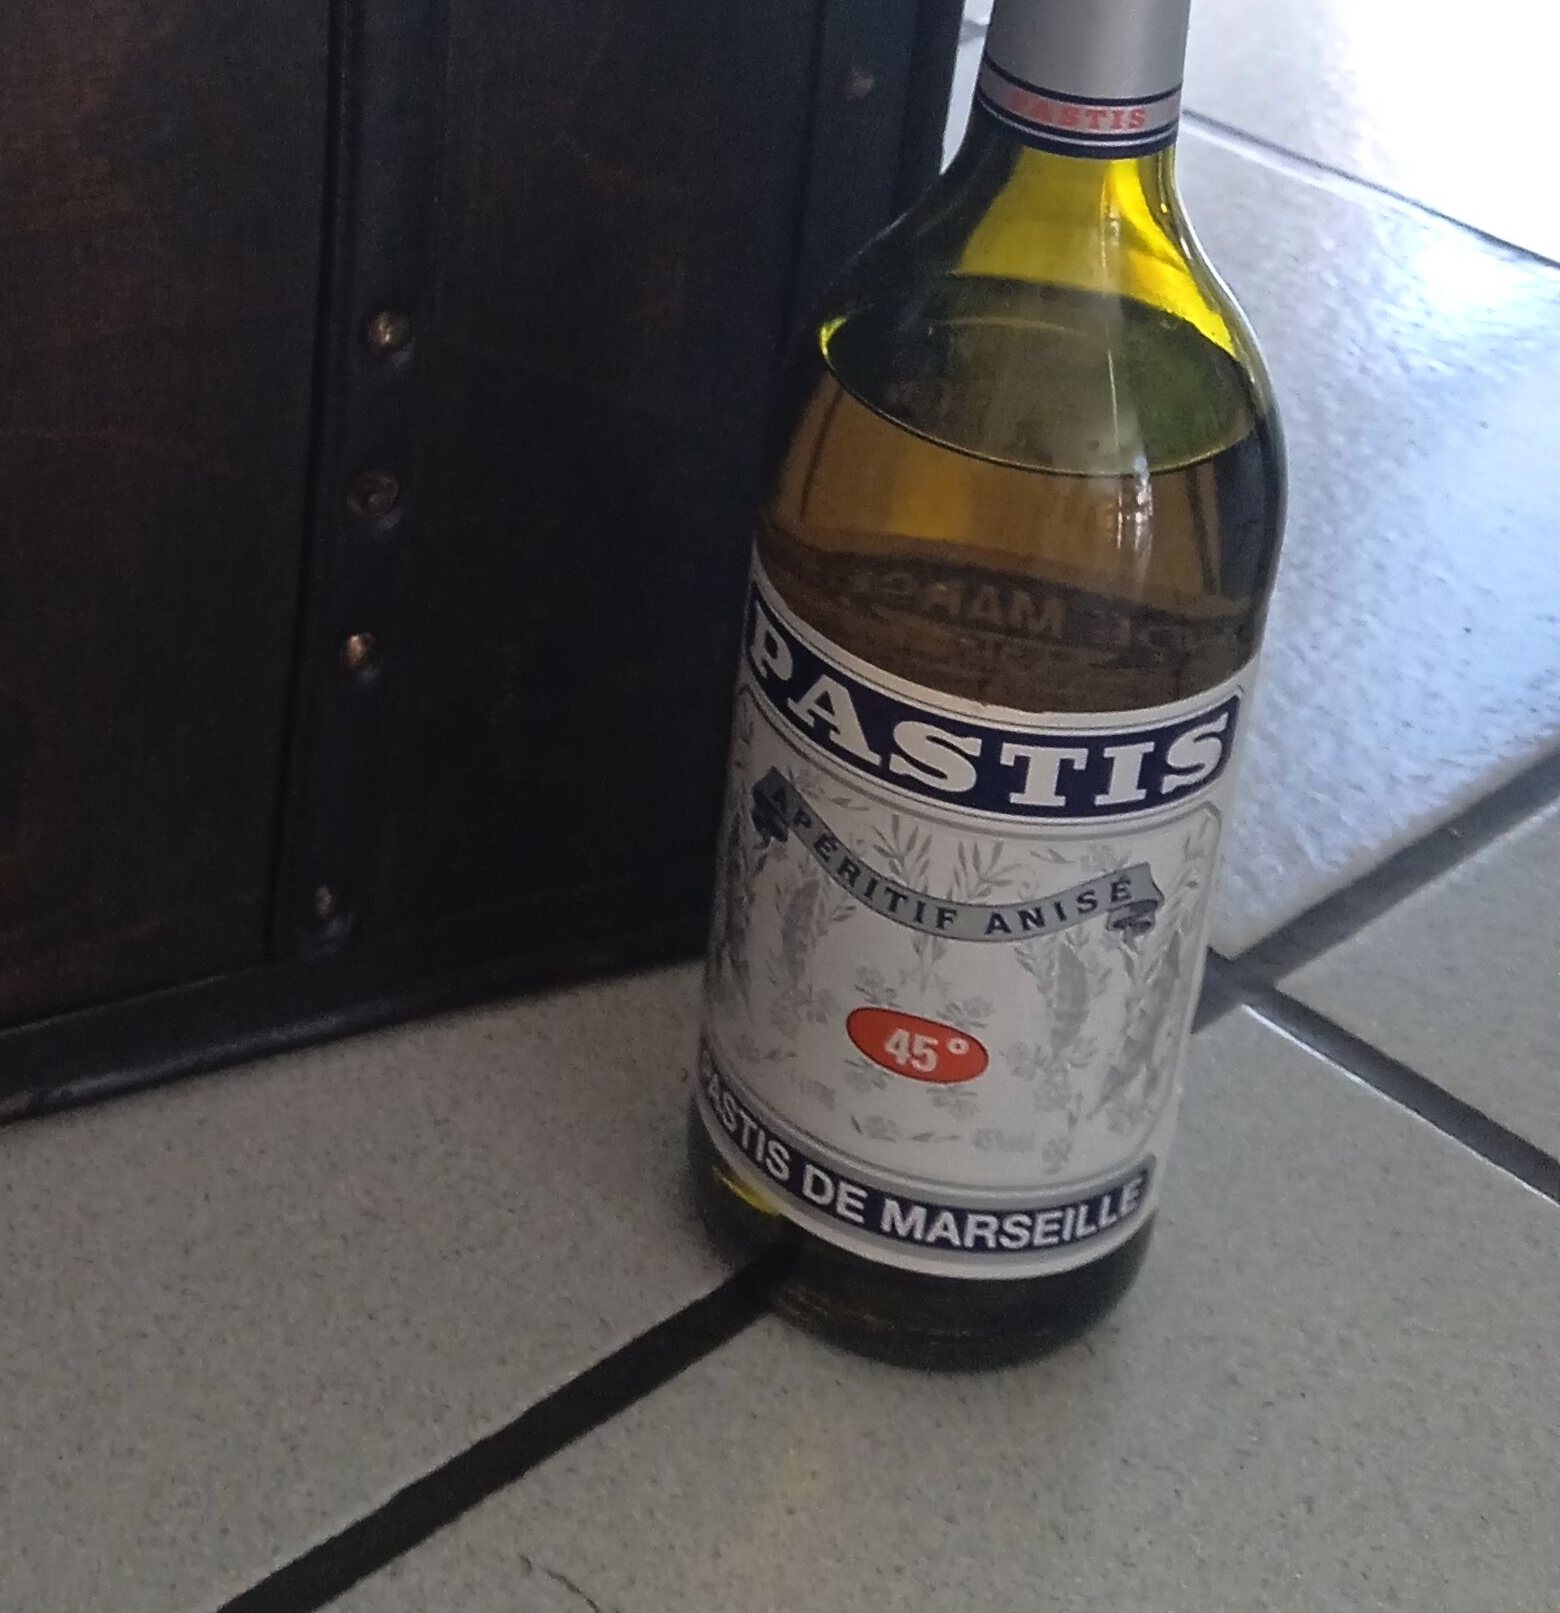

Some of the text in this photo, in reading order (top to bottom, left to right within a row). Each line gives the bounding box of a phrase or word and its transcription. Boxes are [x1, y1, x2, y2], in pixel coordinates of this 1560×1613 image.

[750, 602, 1231, 808] PASTIS
[884, 1028, 970, 1073] 45°
[802, 1163, 866, 1224] DE
[880, 1179, 1142, 1249] MARSEILLE
